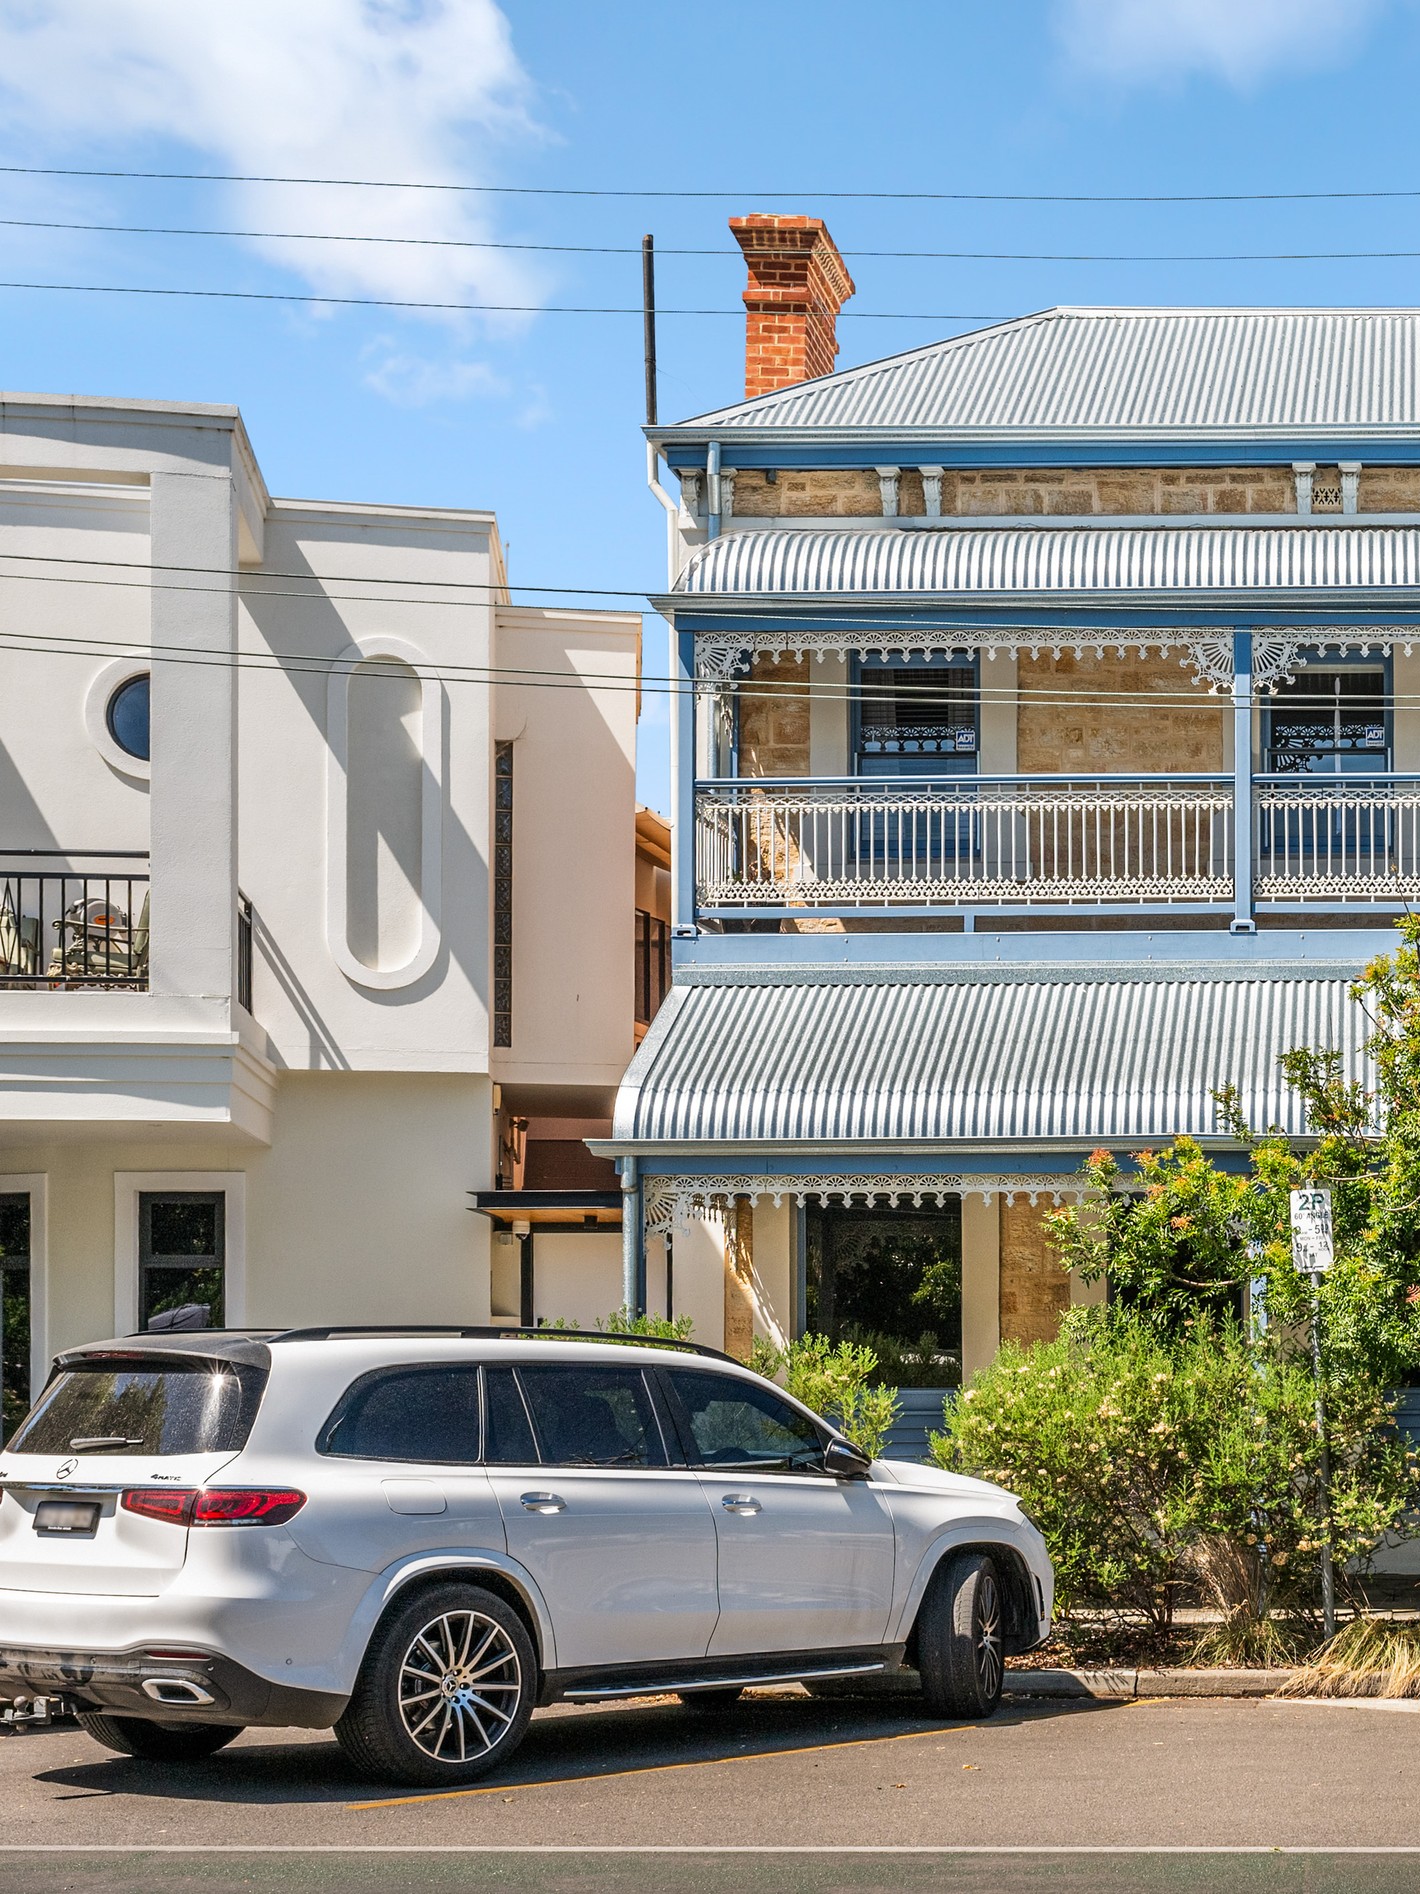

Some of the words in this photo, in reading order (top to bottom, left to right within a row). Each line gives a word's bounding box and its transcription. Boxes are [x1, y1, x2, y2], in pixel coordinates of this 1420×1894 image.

[958, 734, 975, 743] ADT
[1367, 730, 1383, 739] ADT
[1299, 1193, 1325, 1211] 2P
[1306, 1211, 1329, 1219] ANGLE
